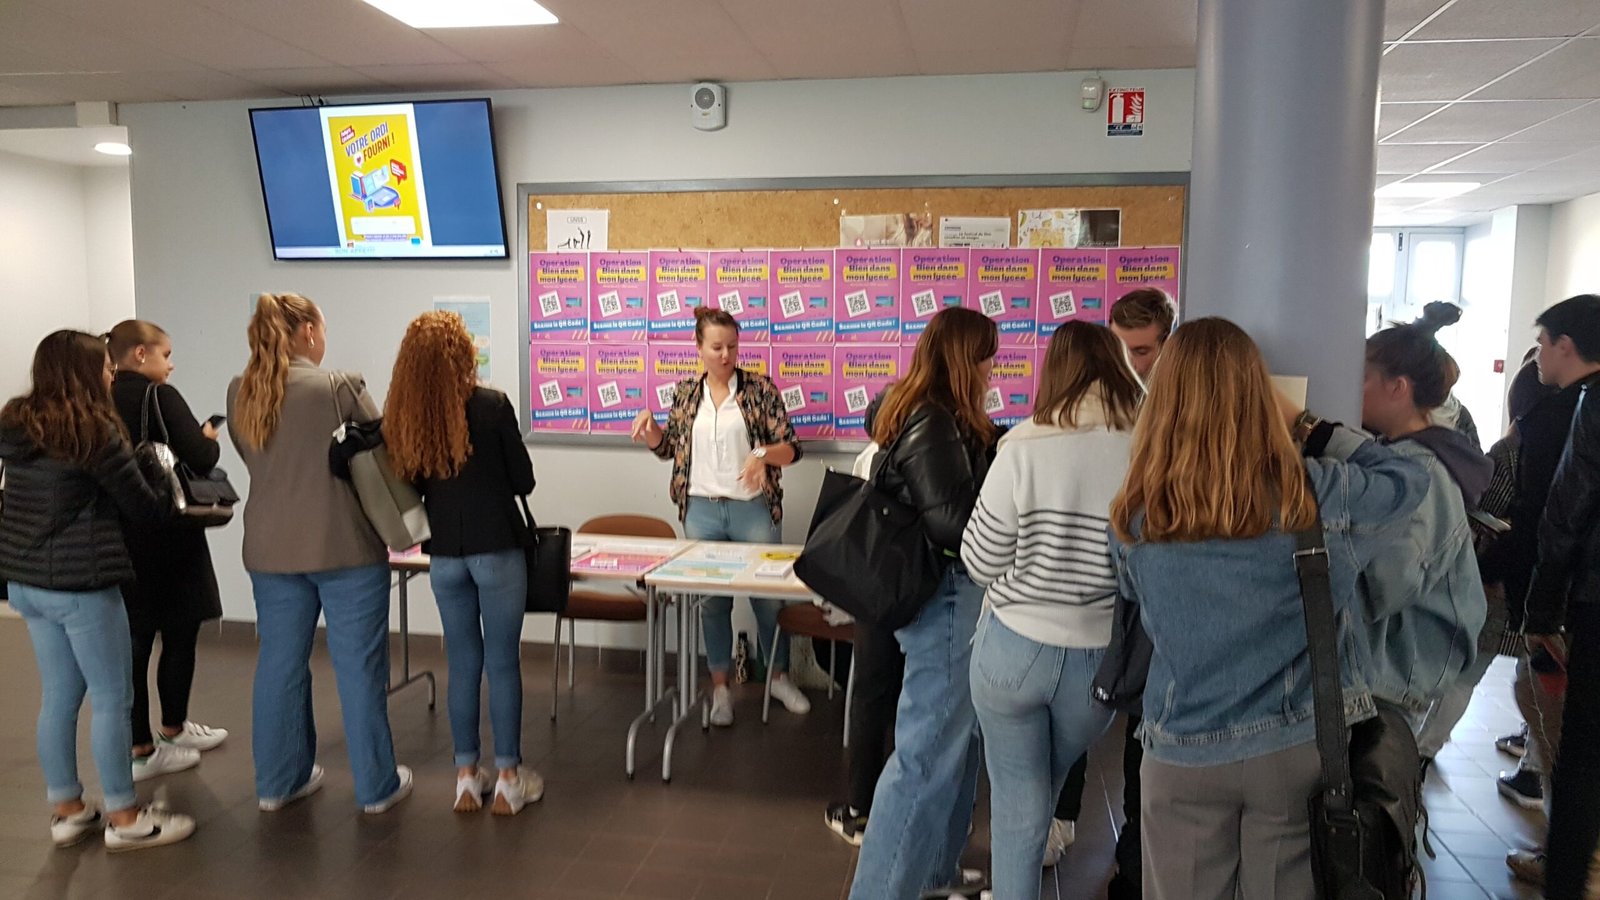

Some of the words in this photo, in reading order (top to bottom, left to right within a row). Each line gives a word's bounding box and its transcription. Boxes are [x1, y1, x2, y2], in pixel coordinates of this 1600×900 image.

[346, 134, 368, 157] VOTRE
[370, 121, 388, 142] ORDI
[363, 135, 390, 162] FOURNI
[392, 132, 395, 144] !
